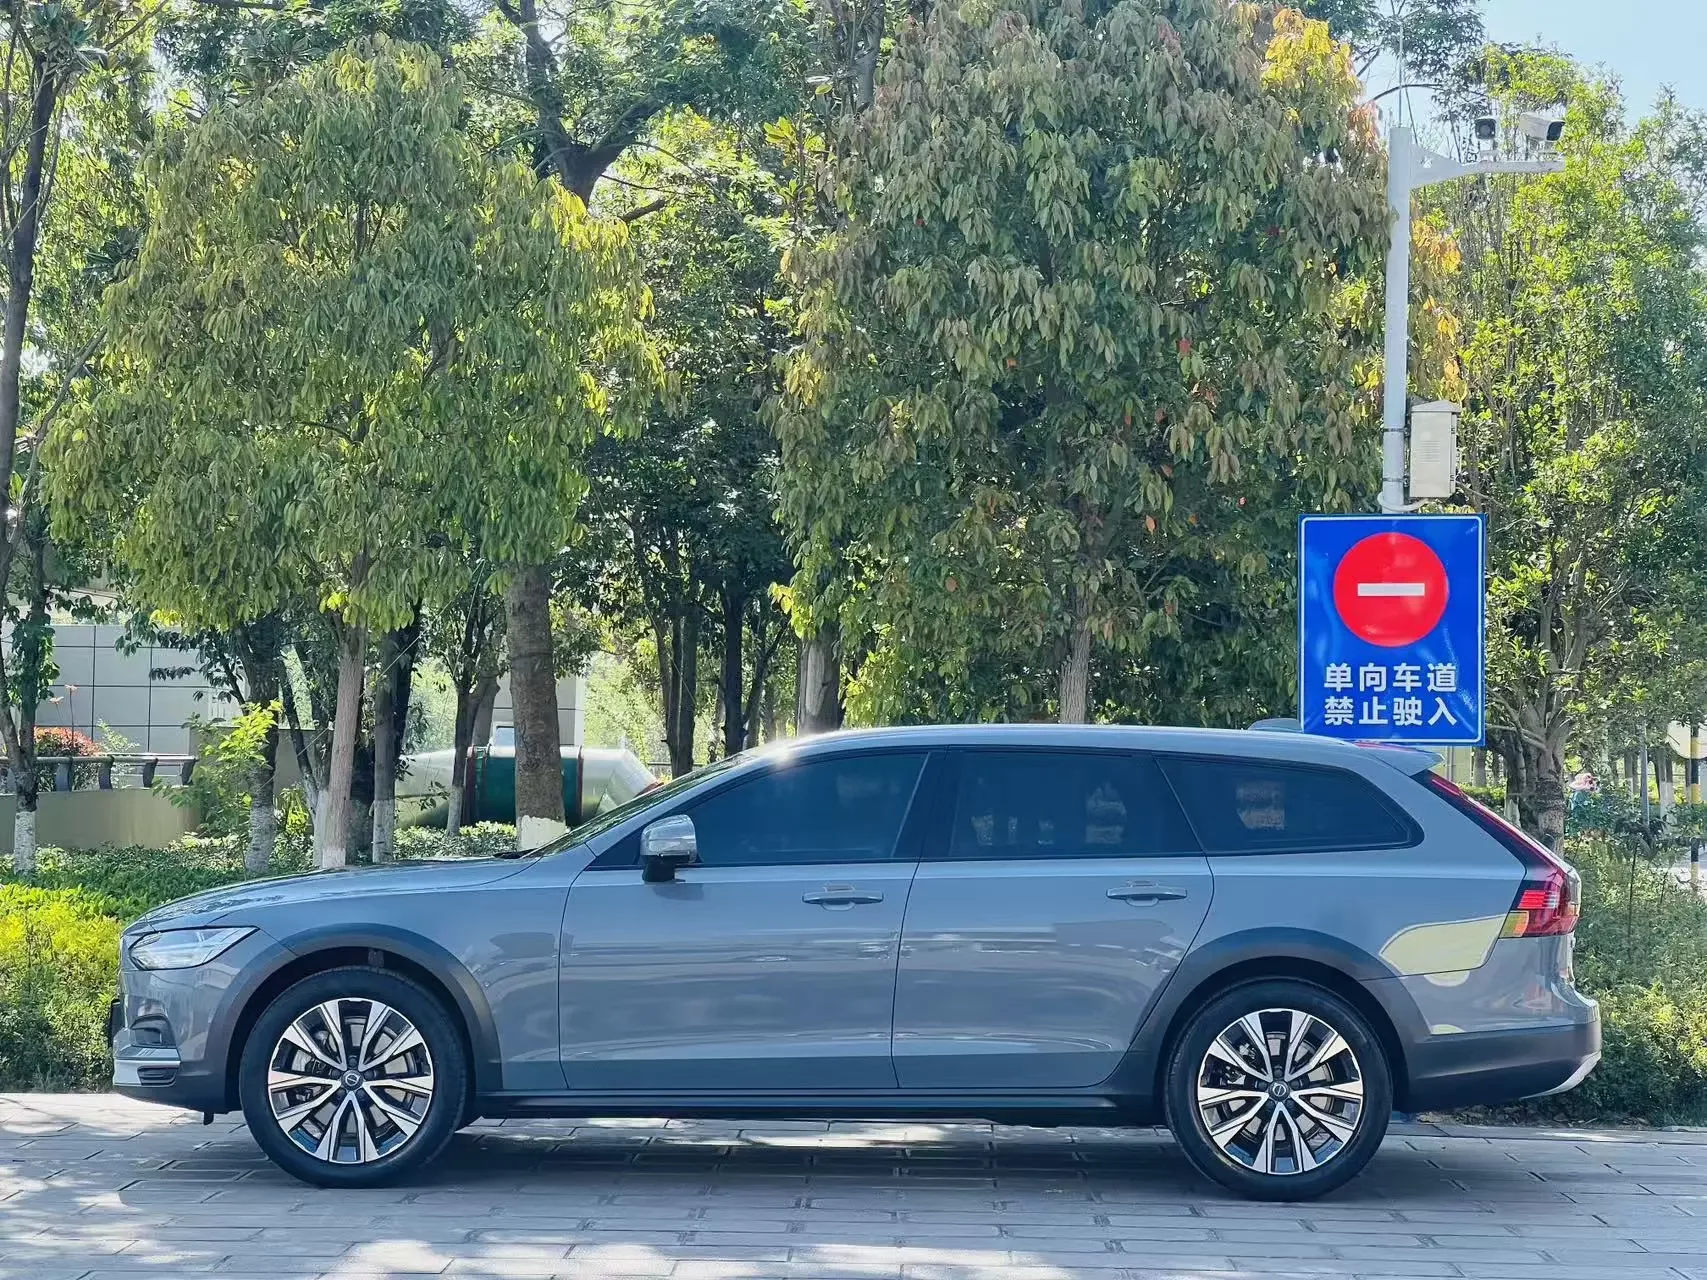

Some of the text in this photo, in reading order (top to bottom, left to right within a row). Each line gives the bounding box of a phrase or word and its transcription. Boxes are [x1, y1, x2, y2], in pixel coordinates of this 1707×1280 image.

[1324, 663, 1457, 692] 单向车道
[1324, 696, 1457, 726] 禁止驶入
